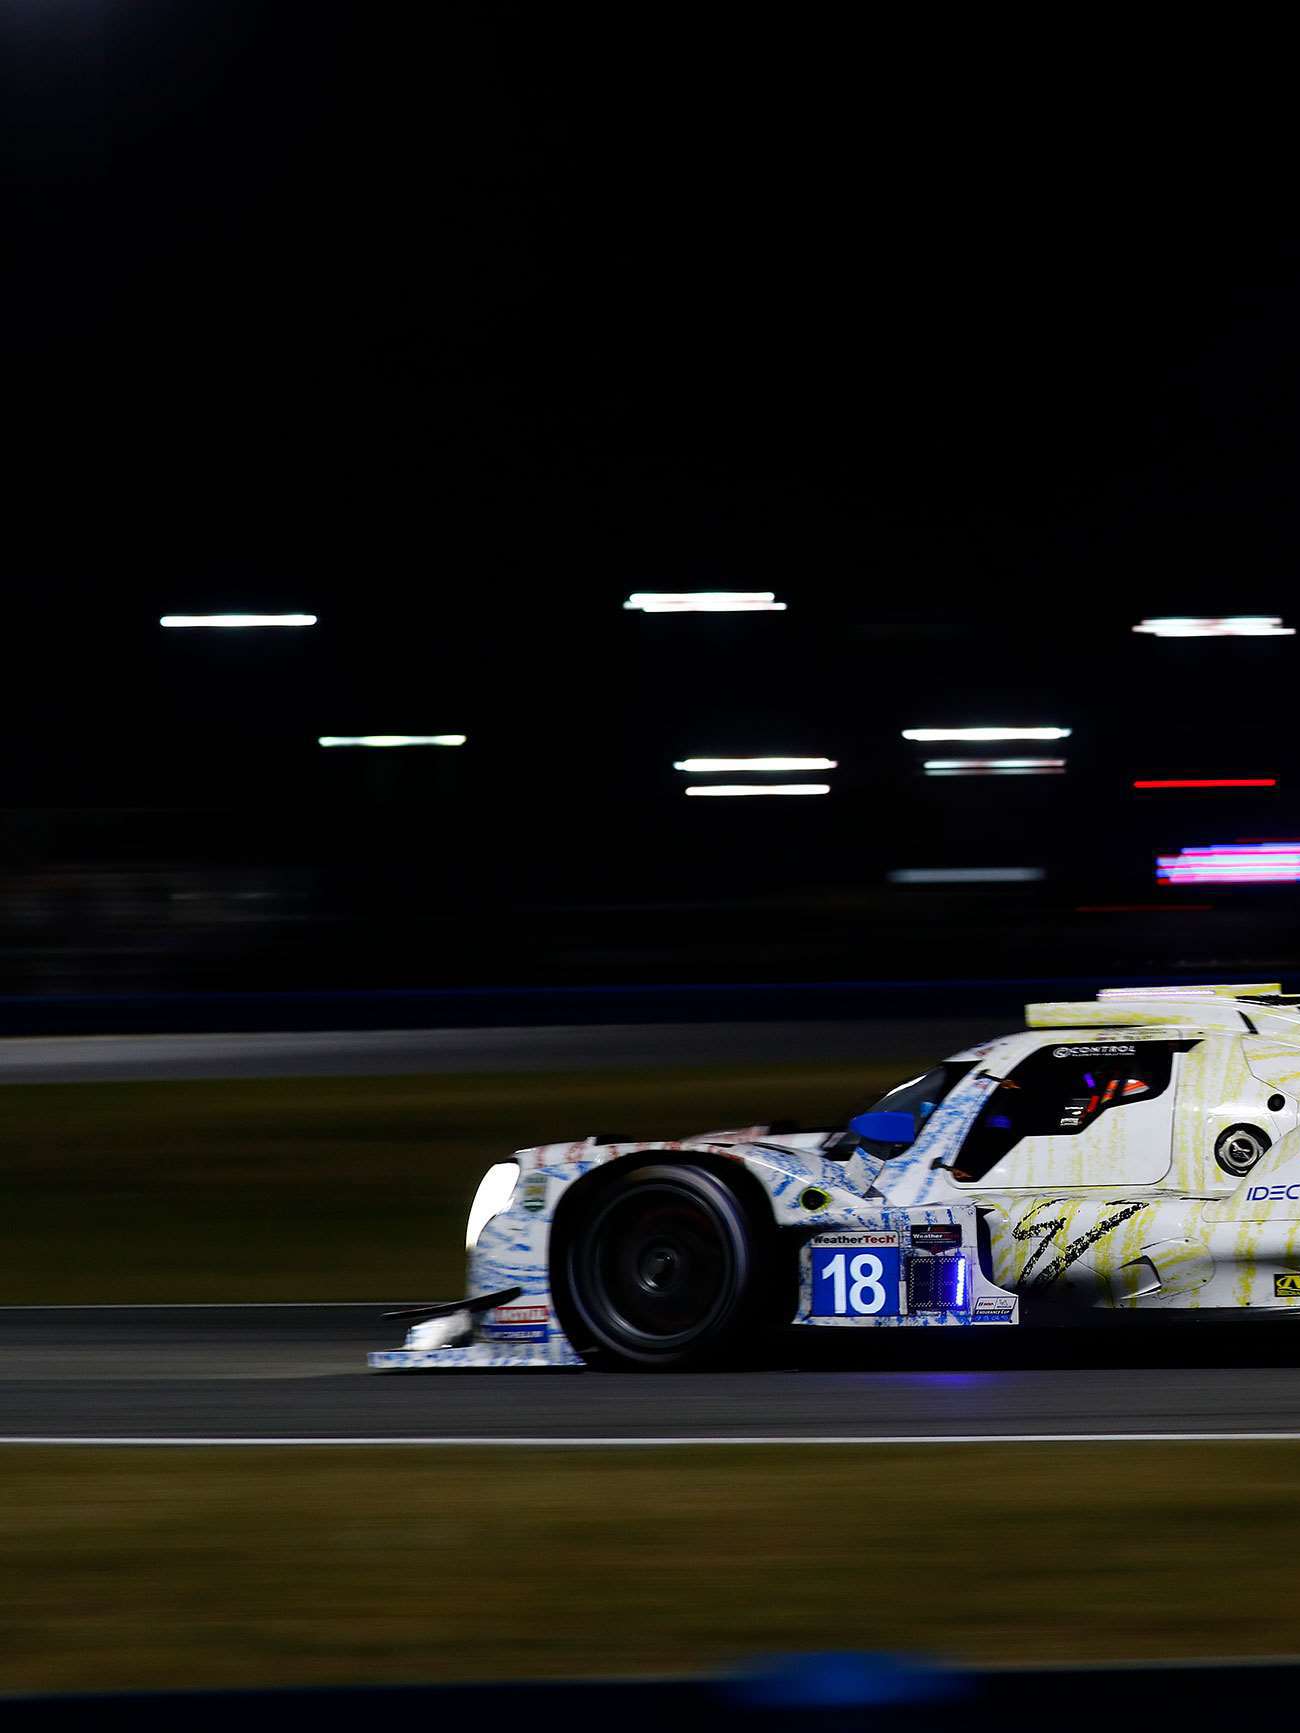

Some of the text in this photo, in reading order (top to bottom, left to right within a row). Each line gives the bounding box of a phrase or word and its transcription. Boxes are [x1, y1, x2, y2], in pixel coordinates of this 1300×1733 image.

[1071, 1045, 1137, 1054] CONTROL
[1246, 1184, 1300, 1201] IDEC
[822, 1253, 887, 1314] 18
